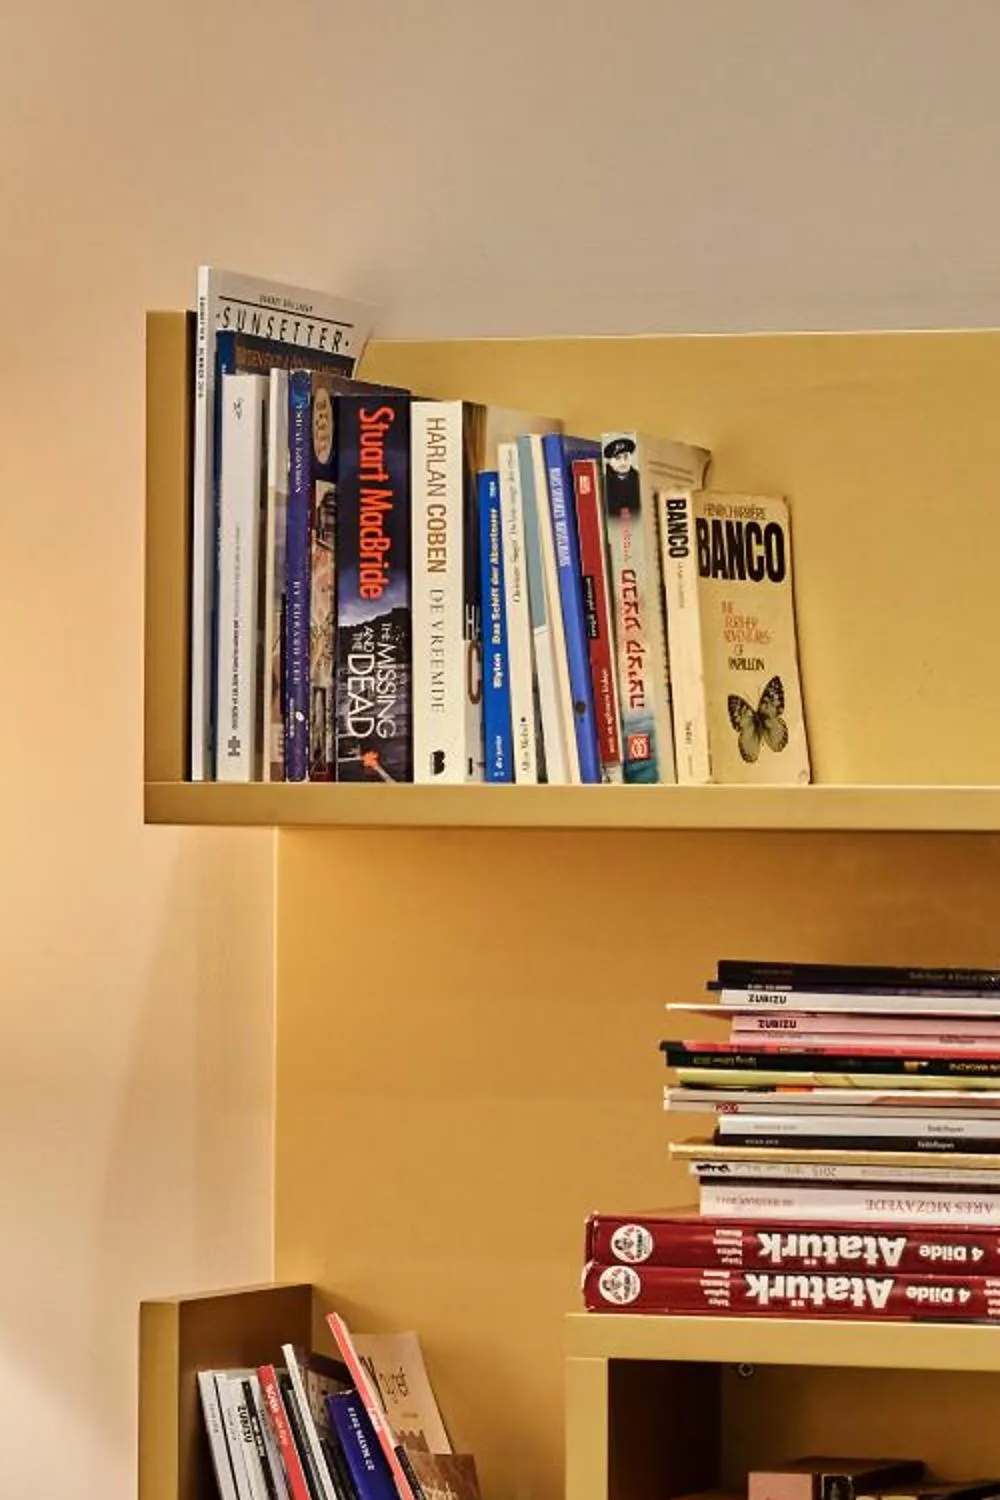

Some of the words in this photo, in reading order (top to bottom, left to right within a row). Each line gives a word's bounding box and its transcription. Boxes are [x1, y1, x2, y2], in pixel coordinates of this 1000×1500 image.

[222, 306, 343, 352] SUNSETTER
[359, 406, 395, 482] Stuart
[426, 417, 447, 497] HARLAN
[359, 487, 394, 600] MacBride
[426, 503, 448, 574] COBEN
[666, 498, 690, 559] BANCO
[696, 517, 787, 584] BANCO
[430, 589, 445, 615] DE
[363, 625, 375, 653] AND
[376, 641, 397, 739] MISSING
[430, 620, 445, 714] VREEMDE
[347, 653, 375, 738] DEAD
[757, 1231, 907, 1268] Atatürk
[919, 1244, 969, 1261] Dilde
[972, 1246, 984, 1260] 4
[744, 1273, 895, 1310] Atatürk
[905, 1284, 956, 1303] Dilde
[958, 1286, 971, 1301] 4
